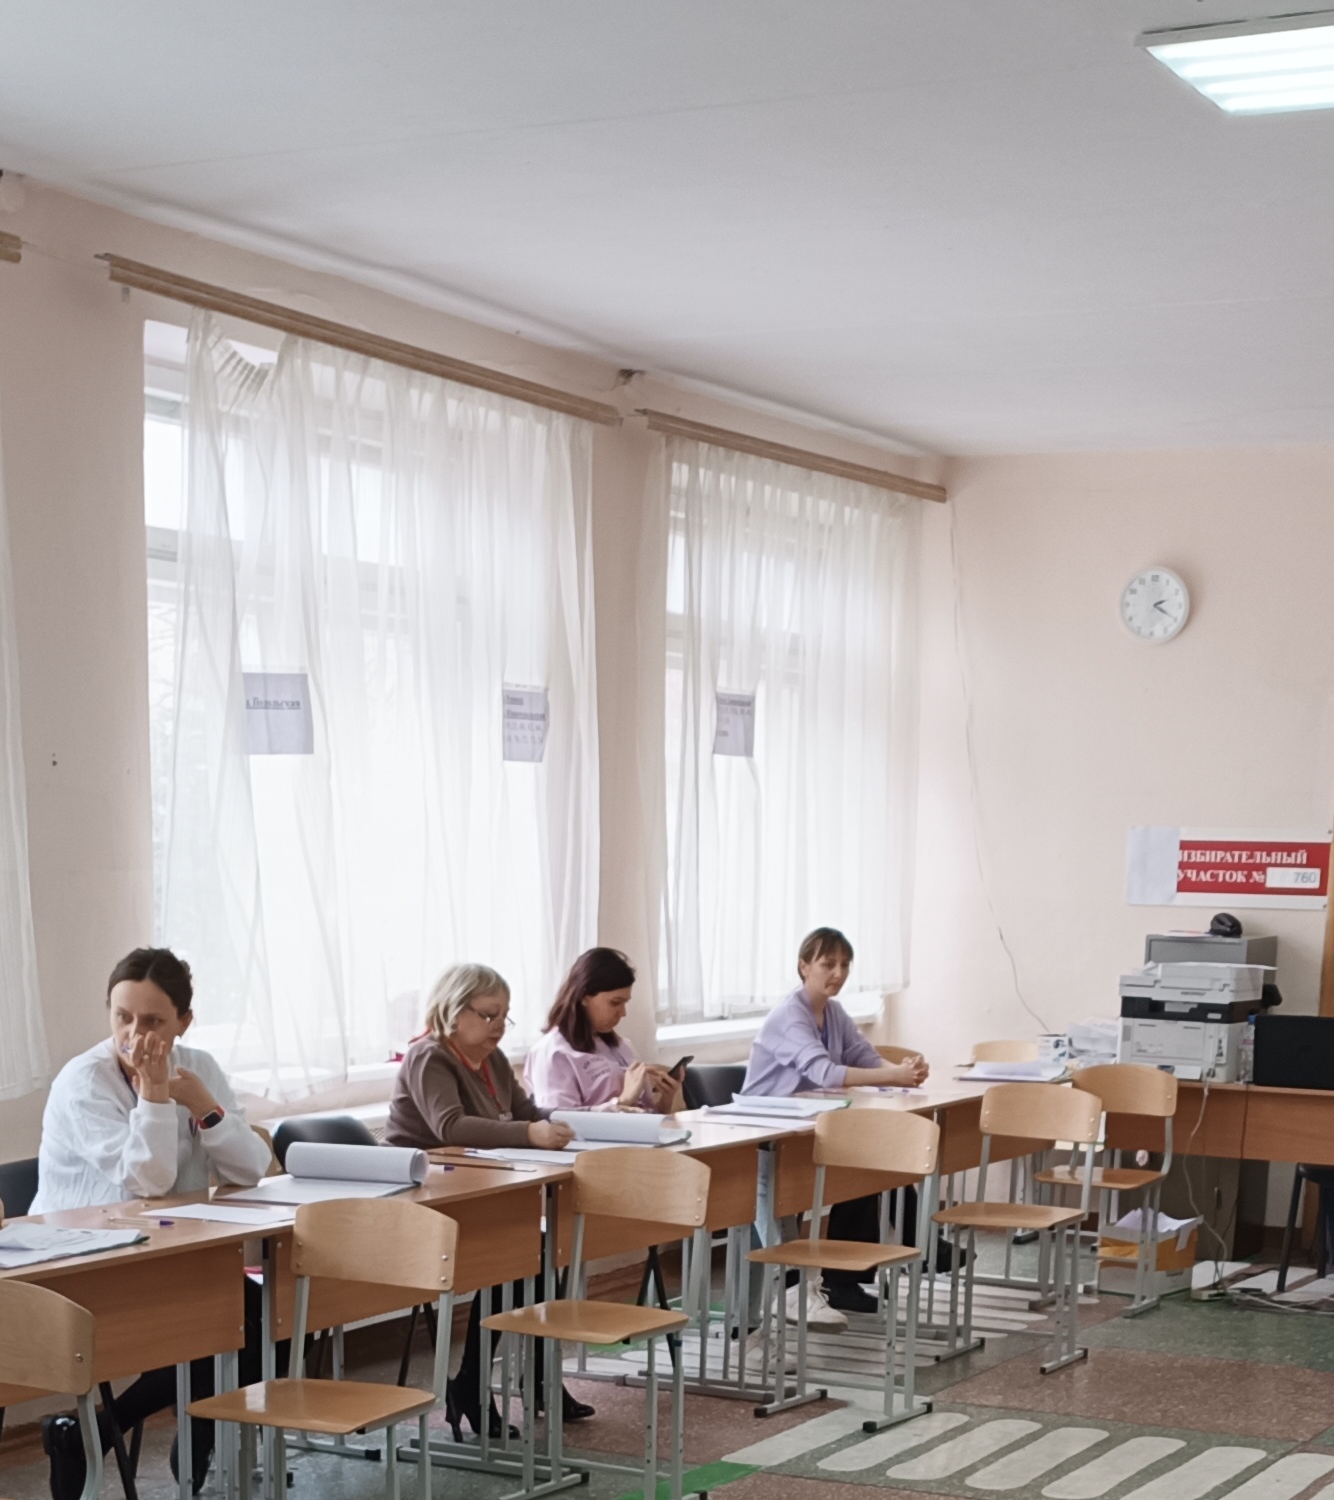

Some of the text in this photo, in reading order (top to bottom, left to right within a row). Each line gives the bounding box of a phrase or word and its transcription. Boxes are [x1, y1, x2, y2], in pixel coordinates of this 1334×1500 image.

[1177, 849, 1308, 865] ИЗБИРАТЕЛЬНЫЙ
[1177, 868, 1317, 884] УЧАСТОК № 760
